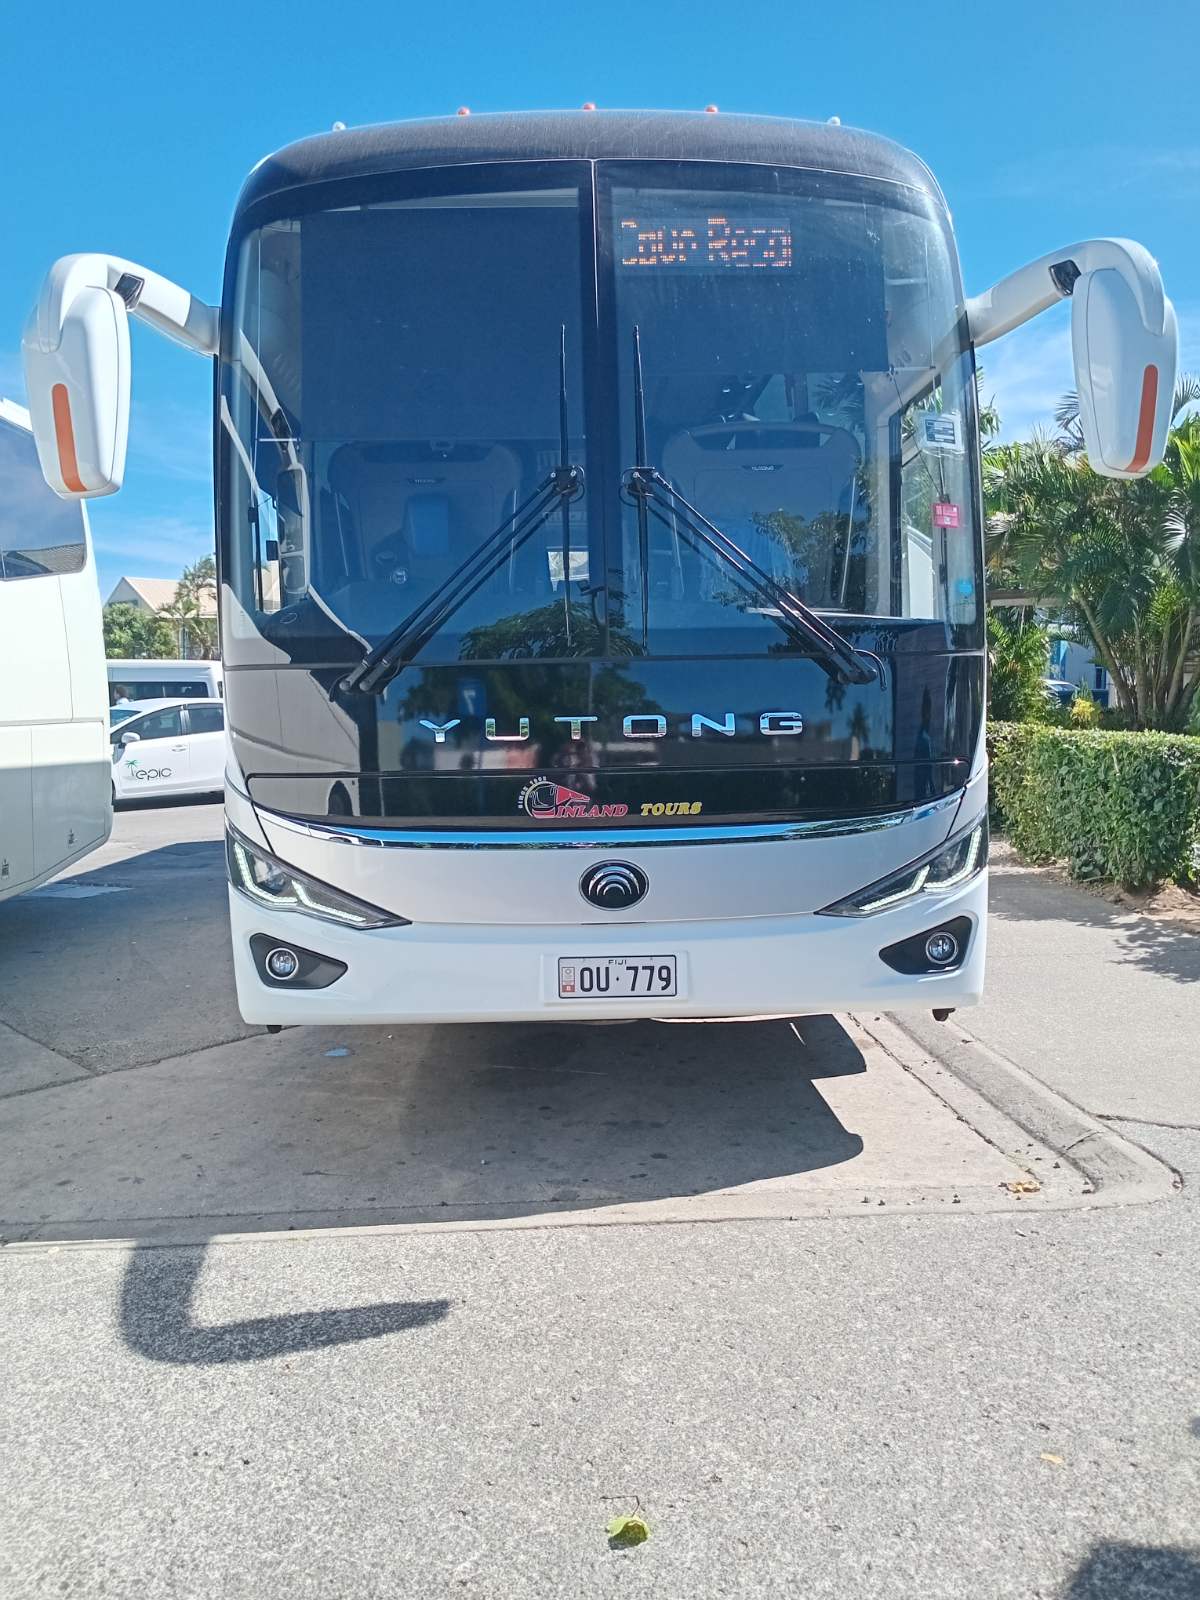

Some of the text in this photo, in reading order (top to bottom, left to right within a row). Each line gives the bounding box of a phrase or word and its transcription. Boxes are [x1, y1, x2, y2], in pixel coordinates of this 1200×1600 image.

[419, 711, 803, 743] YUTONG
[135, 767, 172, 781] epic
[556, 801, 702, 818] INLAND TOURS
